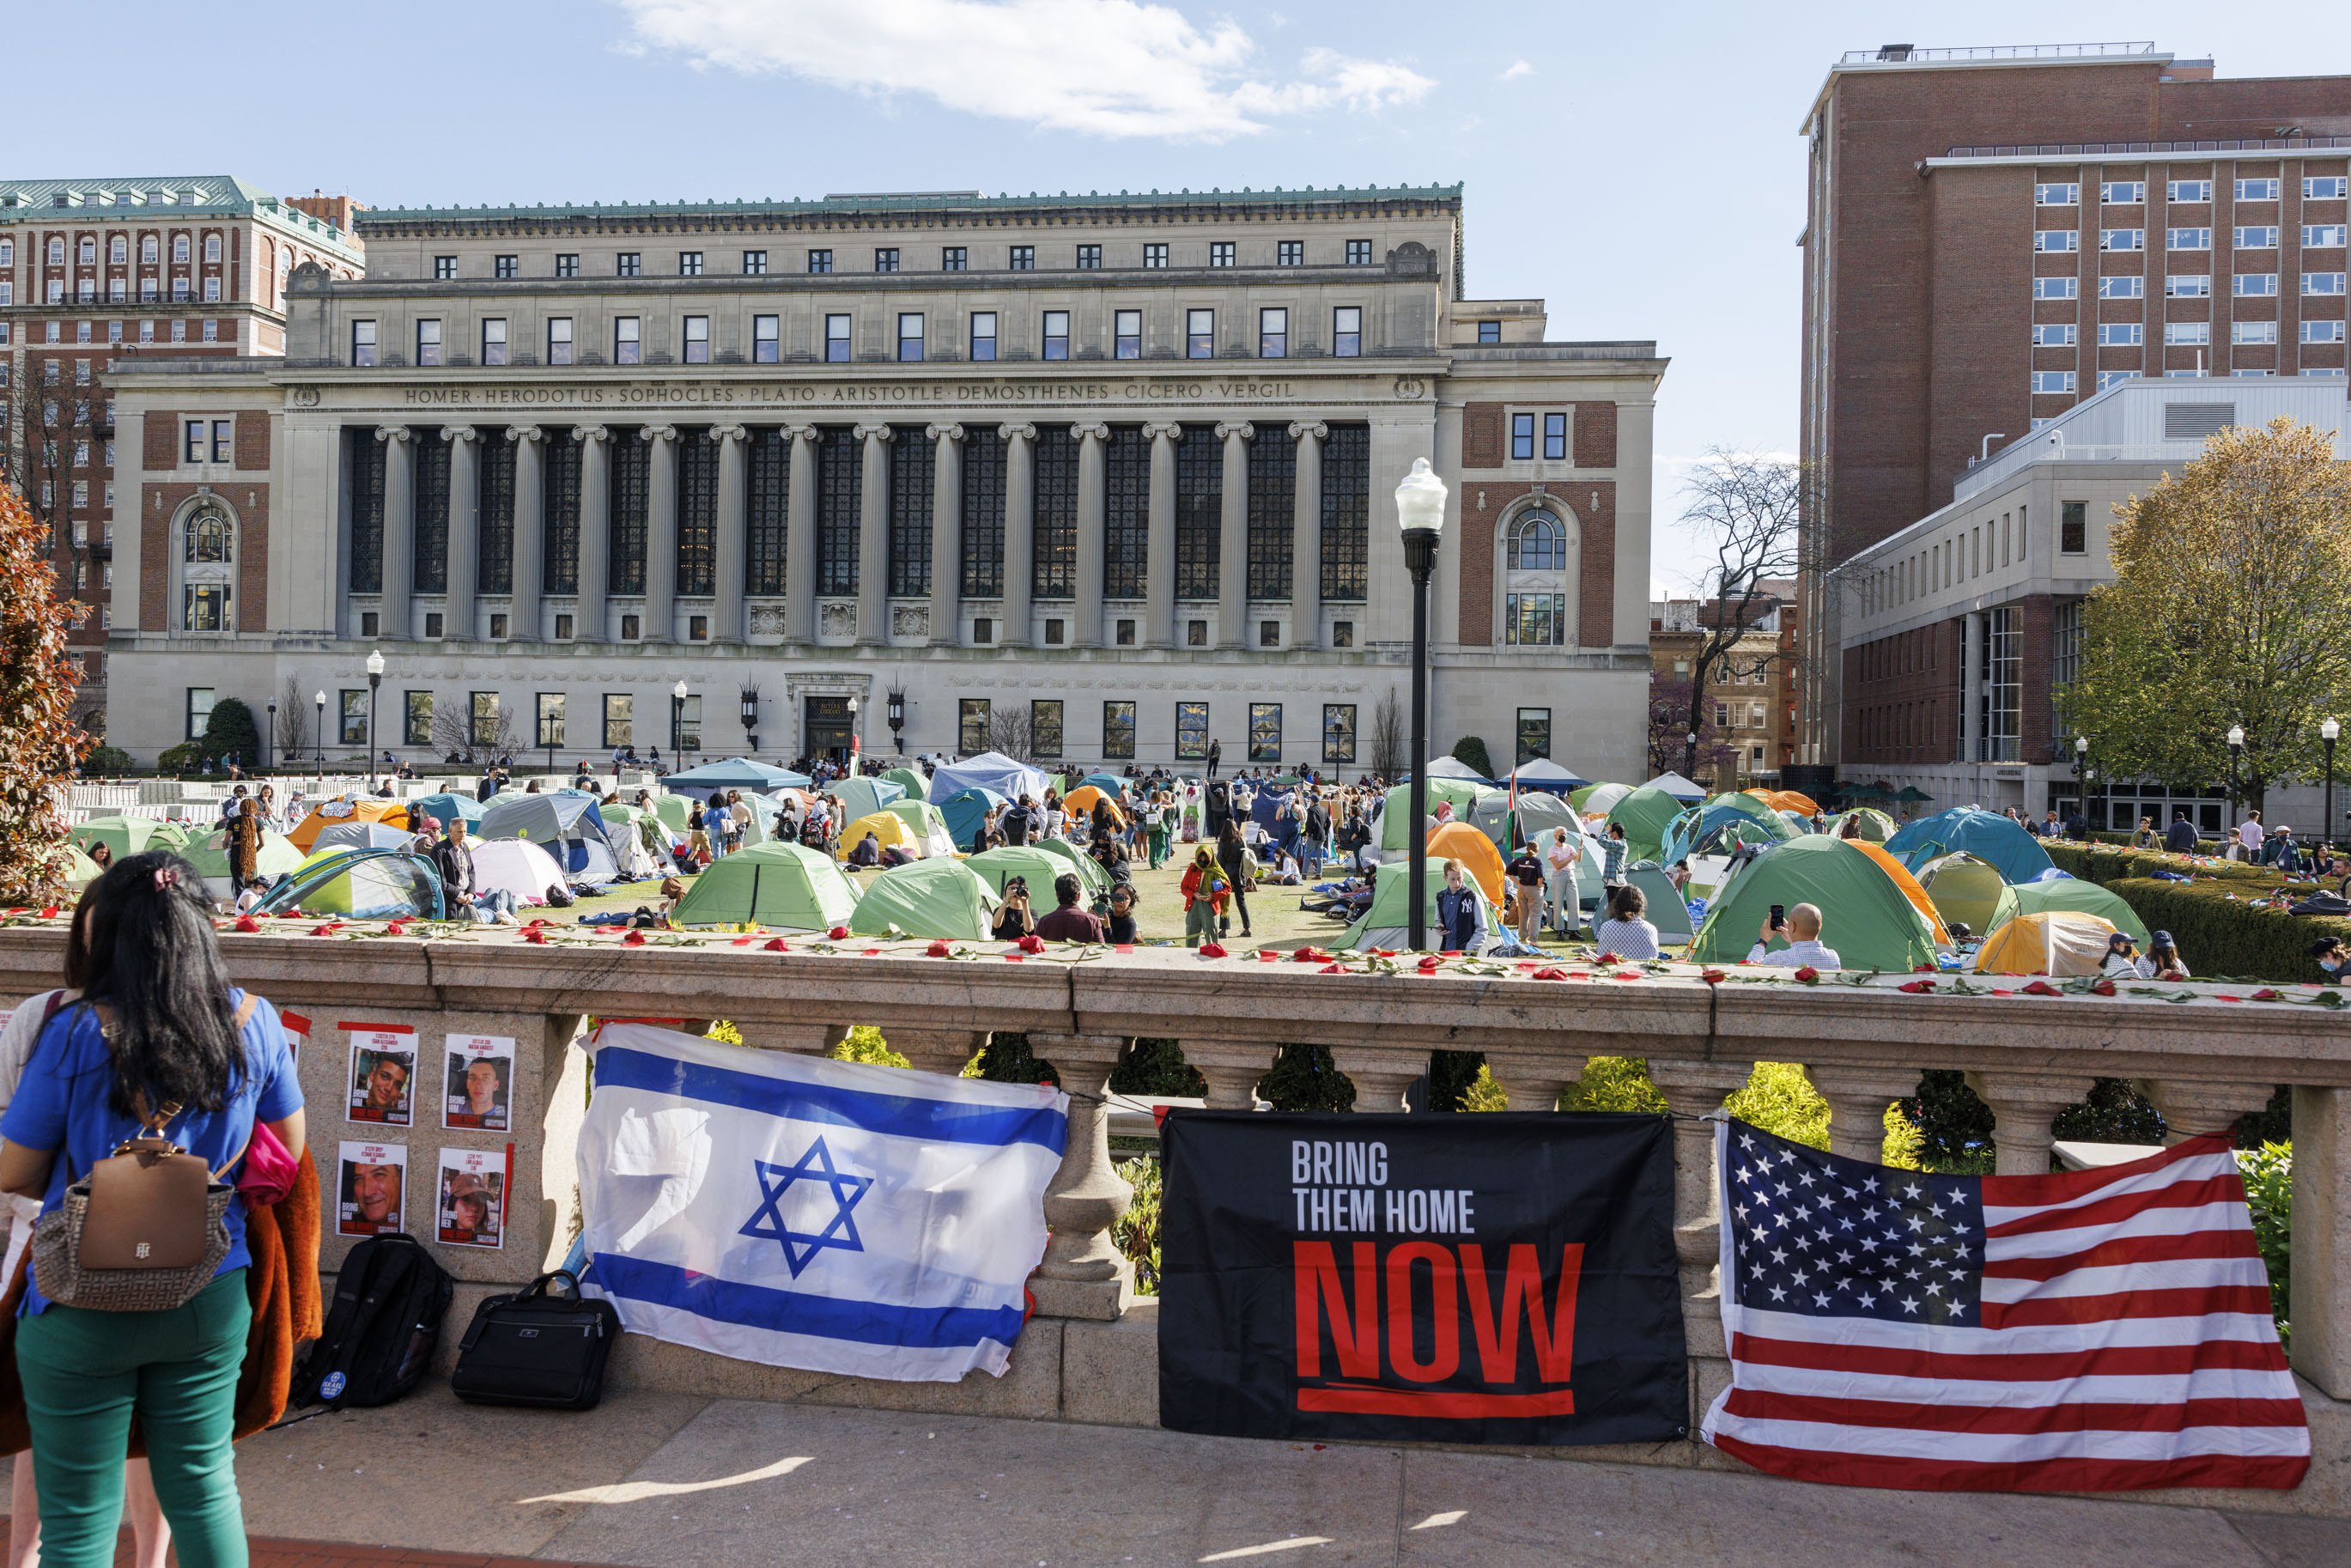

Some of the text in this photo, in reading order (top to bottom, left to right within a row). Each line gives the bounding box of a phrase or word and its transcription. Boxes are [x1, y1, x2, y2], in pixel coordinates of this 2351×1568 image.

[405, 384, 1295, 404] HOMER HERODOTUS SOPHOCLES PLATO ARISTOTLE DEMOSTHENES CICERO VERGIL
[1461, 898, 1473, 913] NY
[353, 1089, 368, 1098] BRING
[448, 1095, 465, 1104] BRING
[448, 1104, 459, 1113] HIM
[1292, 1140, 1388, 1186] BRING
[342, 1202, 358, 1212] BRING
[1292, 1188, 1475, 1234] THEM HOME
[342, 1212, 353, 1220] HIM
[441, 1210, 458, 1219] BRING
[440, 1219, 452, 1228] HER
[1293, 1241, 1585, 1383] NOW
